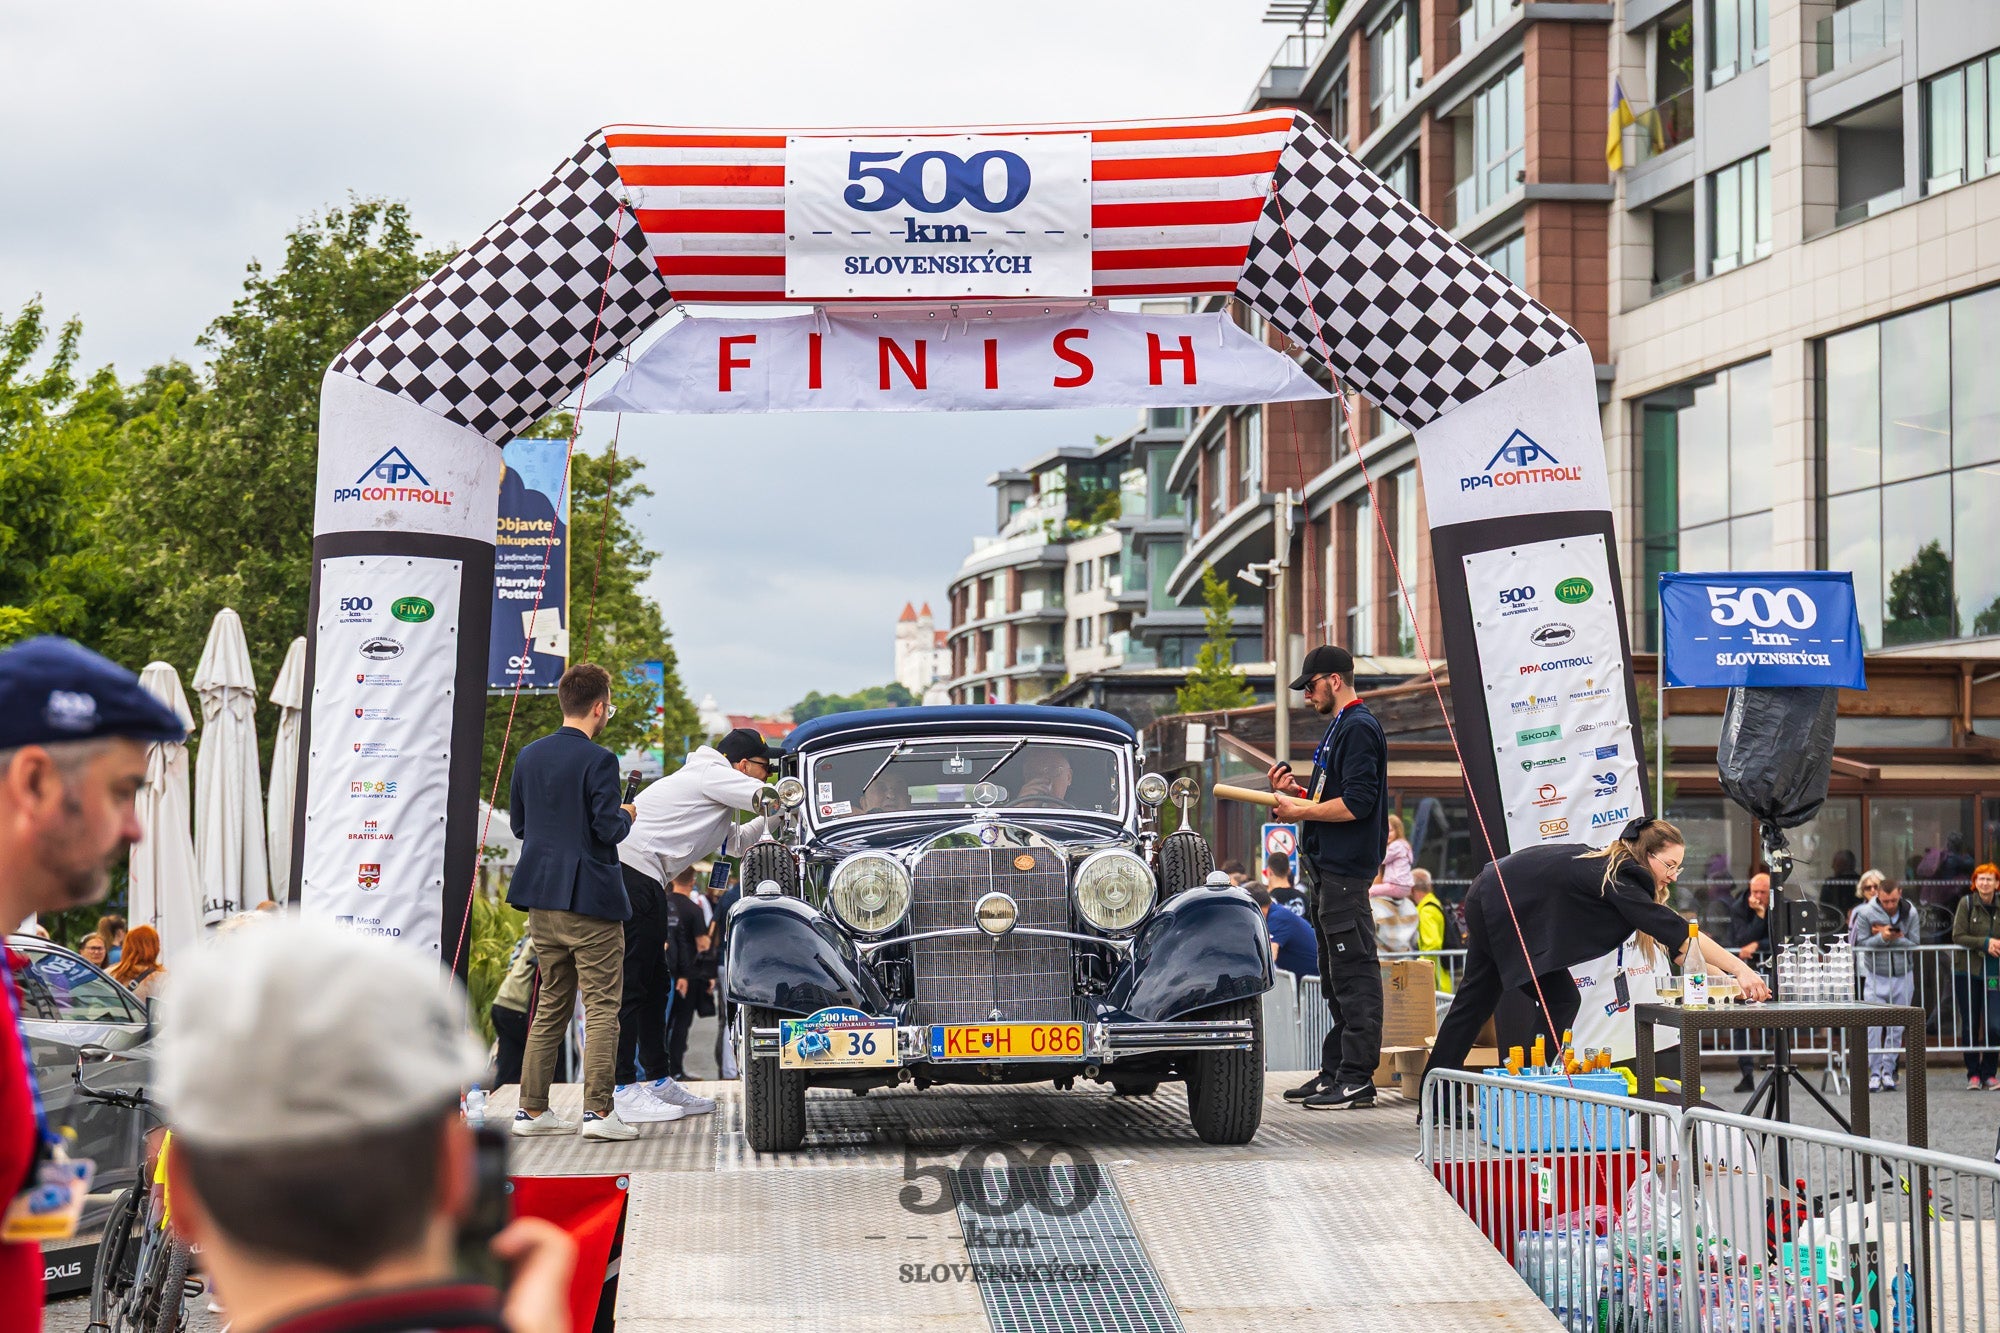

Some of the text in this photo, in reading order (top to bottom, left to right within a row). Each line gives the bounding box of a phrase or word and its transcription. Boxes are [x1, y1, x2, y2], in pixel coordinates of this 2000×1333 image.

[844, 150, 1031, 213] 500
[904, 217, 971, 243] km
[845, 249, 1031, 275] SLOVENSKÝCH
[718, 328, 1197, 392] FINISH
[497, 517, 553, 534] Objavte
[496, 576, 546, 589] Harryho
[1563, 584, 1588, 597] FIVA
[498, 589, 543, 600] Pottera
[1499, 586, 1536, 604] 500
[340, 597, 373, 611] 500
[400, 604, 427, 615] FIVA
[1706, 586, 1817, 629] 500
[1750, 629, 1791, 646] km
[1716, 650, 1831, 666] SLOVENSKÝCH
[1592, 807, 1629, 826] AVENT
[1540, 820, 1569, 833] OBO
[356, 916, 381, 924] Mesto
[820, 1012, 858, 1022] 500 km
[848, 1032, 876, 1056] 36
[933, 1045, 942, 1053] SK
[1031, 1026, 1081, 1053] 086
[41, 1262, 82, 1281] EXUS
